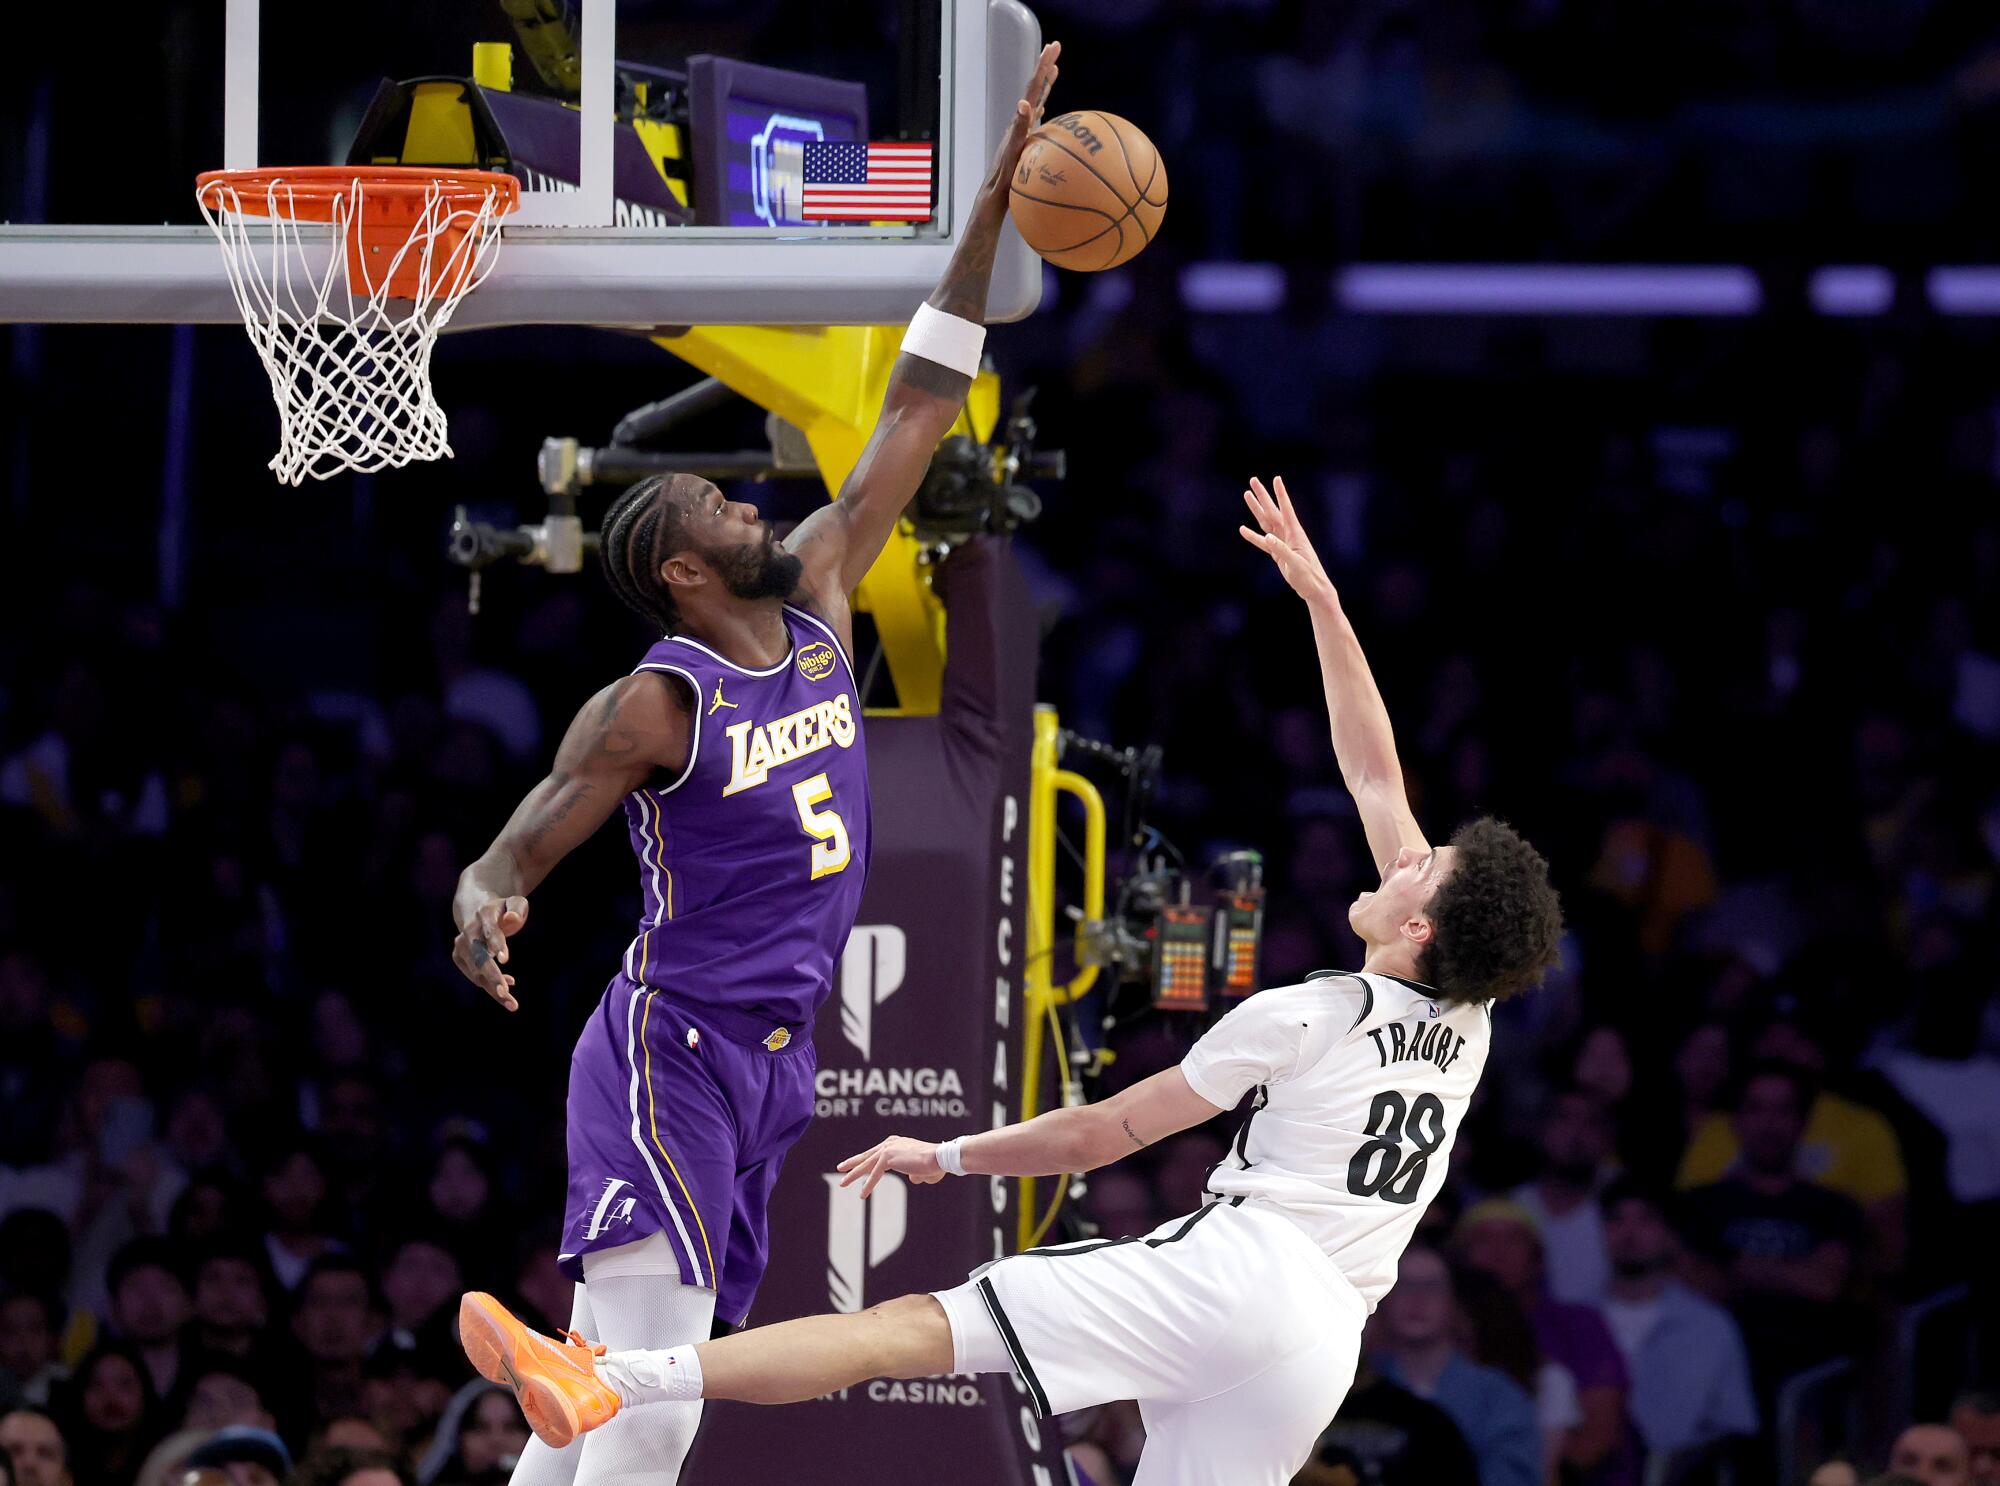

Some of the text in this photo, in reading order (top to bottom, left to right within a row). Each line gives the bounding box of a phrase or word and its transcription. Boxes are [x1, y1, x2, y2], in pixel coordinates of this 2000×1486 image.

[799, 650, 833, 671] bibigo
[723, 693, 856, 798] LAKERS
[791, 772, 851, 881] 5
[1366, 1020, 1466, 1075] TRAORE
[815, 1067, 964, 1097] CHANGA
[815, 1098, 861, 1118] ORT
[1346, 1089, 1446, 1205] 88
